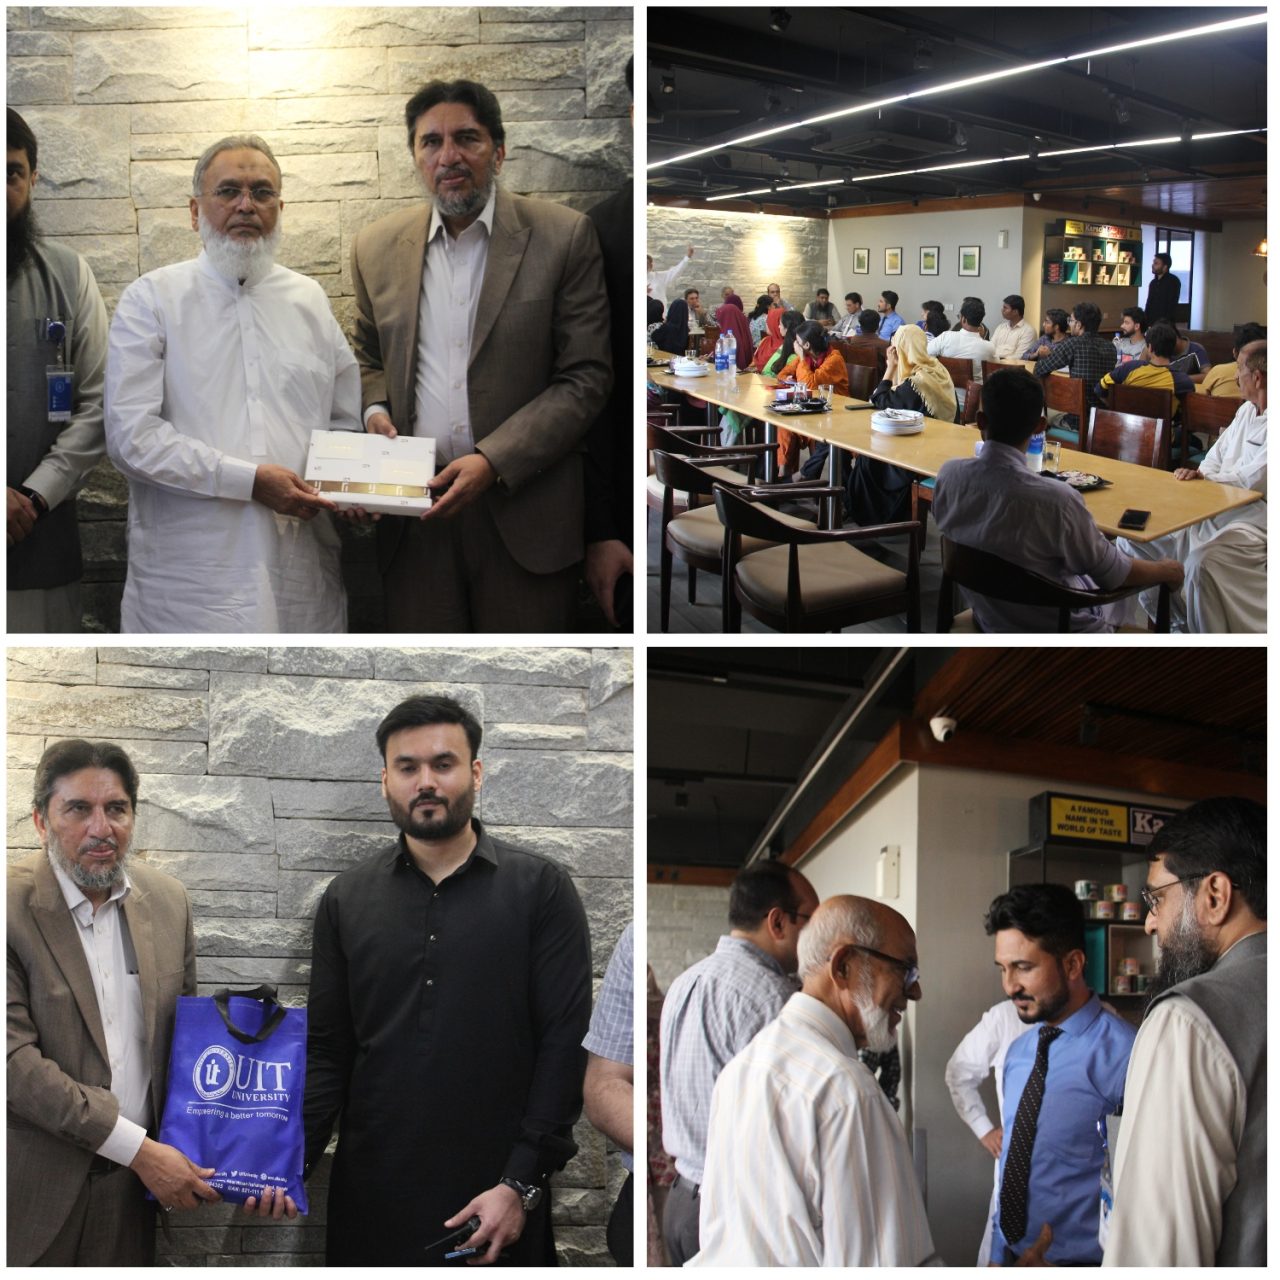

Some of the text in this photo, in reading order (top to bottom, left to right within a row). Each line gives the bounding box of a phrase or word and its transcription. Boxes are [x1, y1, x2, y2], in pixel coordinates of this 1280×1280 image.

[1078, 805, 1109, 816] FAMOUS
[1065, 814, 1115, 826] NAME IN THE
[1057, 823, 1122, 838] WORLD OF TASTE
[236, 1054, 291, 1092] UIT
[232, 1090, 290, 1102] UNIVERSITY
[186, 1106, 224, 1119] Empwering
[230, 1111, 254, 1120] better
